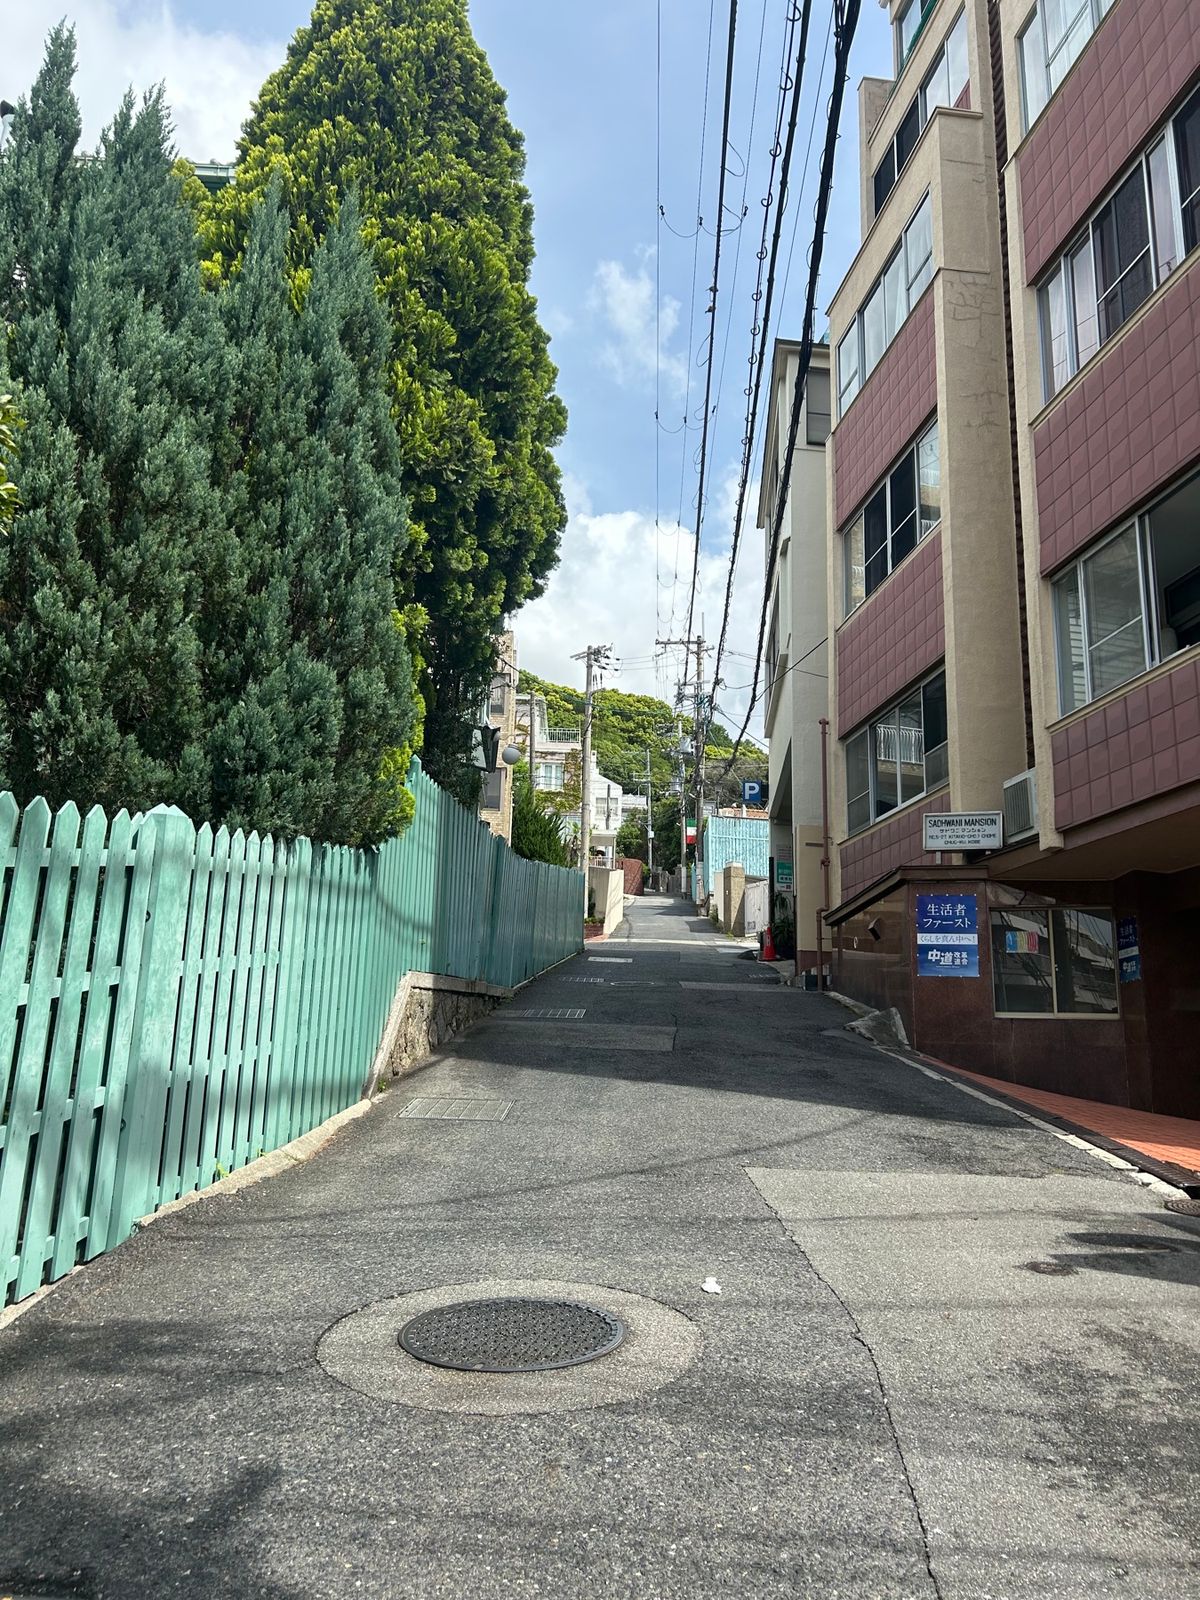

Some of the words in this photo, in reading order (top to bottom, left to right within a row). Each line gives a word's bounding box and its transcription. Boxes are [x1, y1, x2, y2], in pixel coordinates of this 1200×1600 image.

[745, 783, 759, 799] P
[928, 819, 962, 828] SADHWANI
[964, 818, 997, 827] MANSION
[927, 903, 966, 916] 生活者
[923, 917, 971, 928] ファースト
[928, 949, 953, 965] 中道
